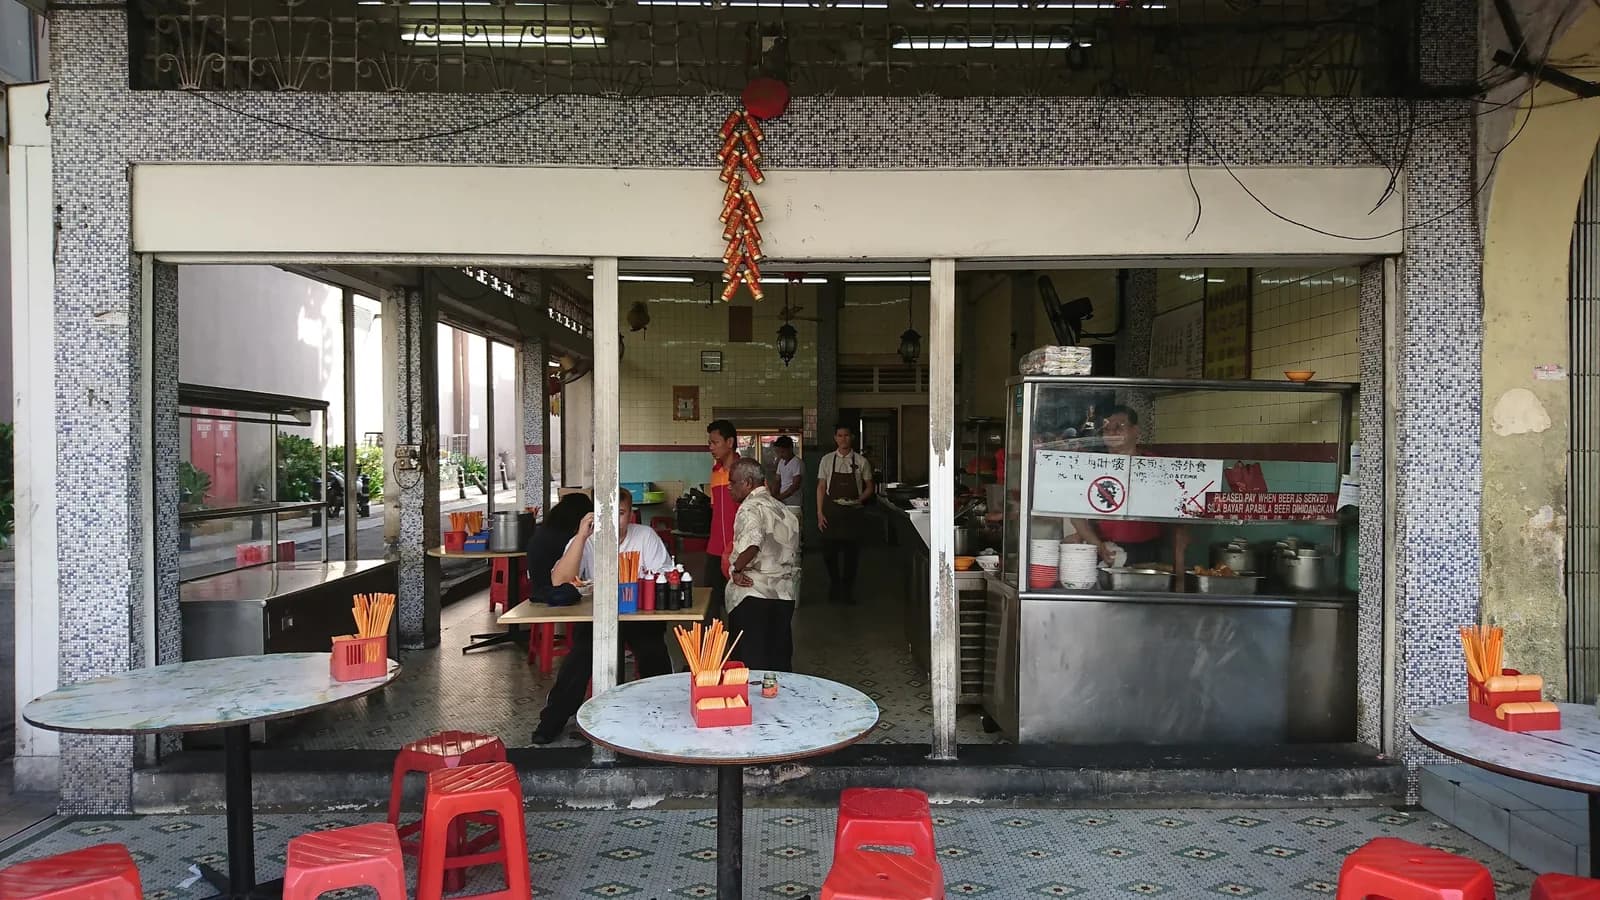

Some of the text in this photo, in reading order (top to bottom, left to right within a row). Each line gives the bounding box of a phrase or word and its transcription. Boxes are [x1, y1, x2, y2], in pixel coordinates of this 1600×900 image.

[1214, 493, 1328, 503] PLEASED PAY WHEN BEER IS SERVED
[1207, 503, 1221, 513] SILA
[1223, 503, 1244, 513] BAYAR
[1246, 503, 1272, 513] APABILA
[1274, 504, 1291, 514] BEER
